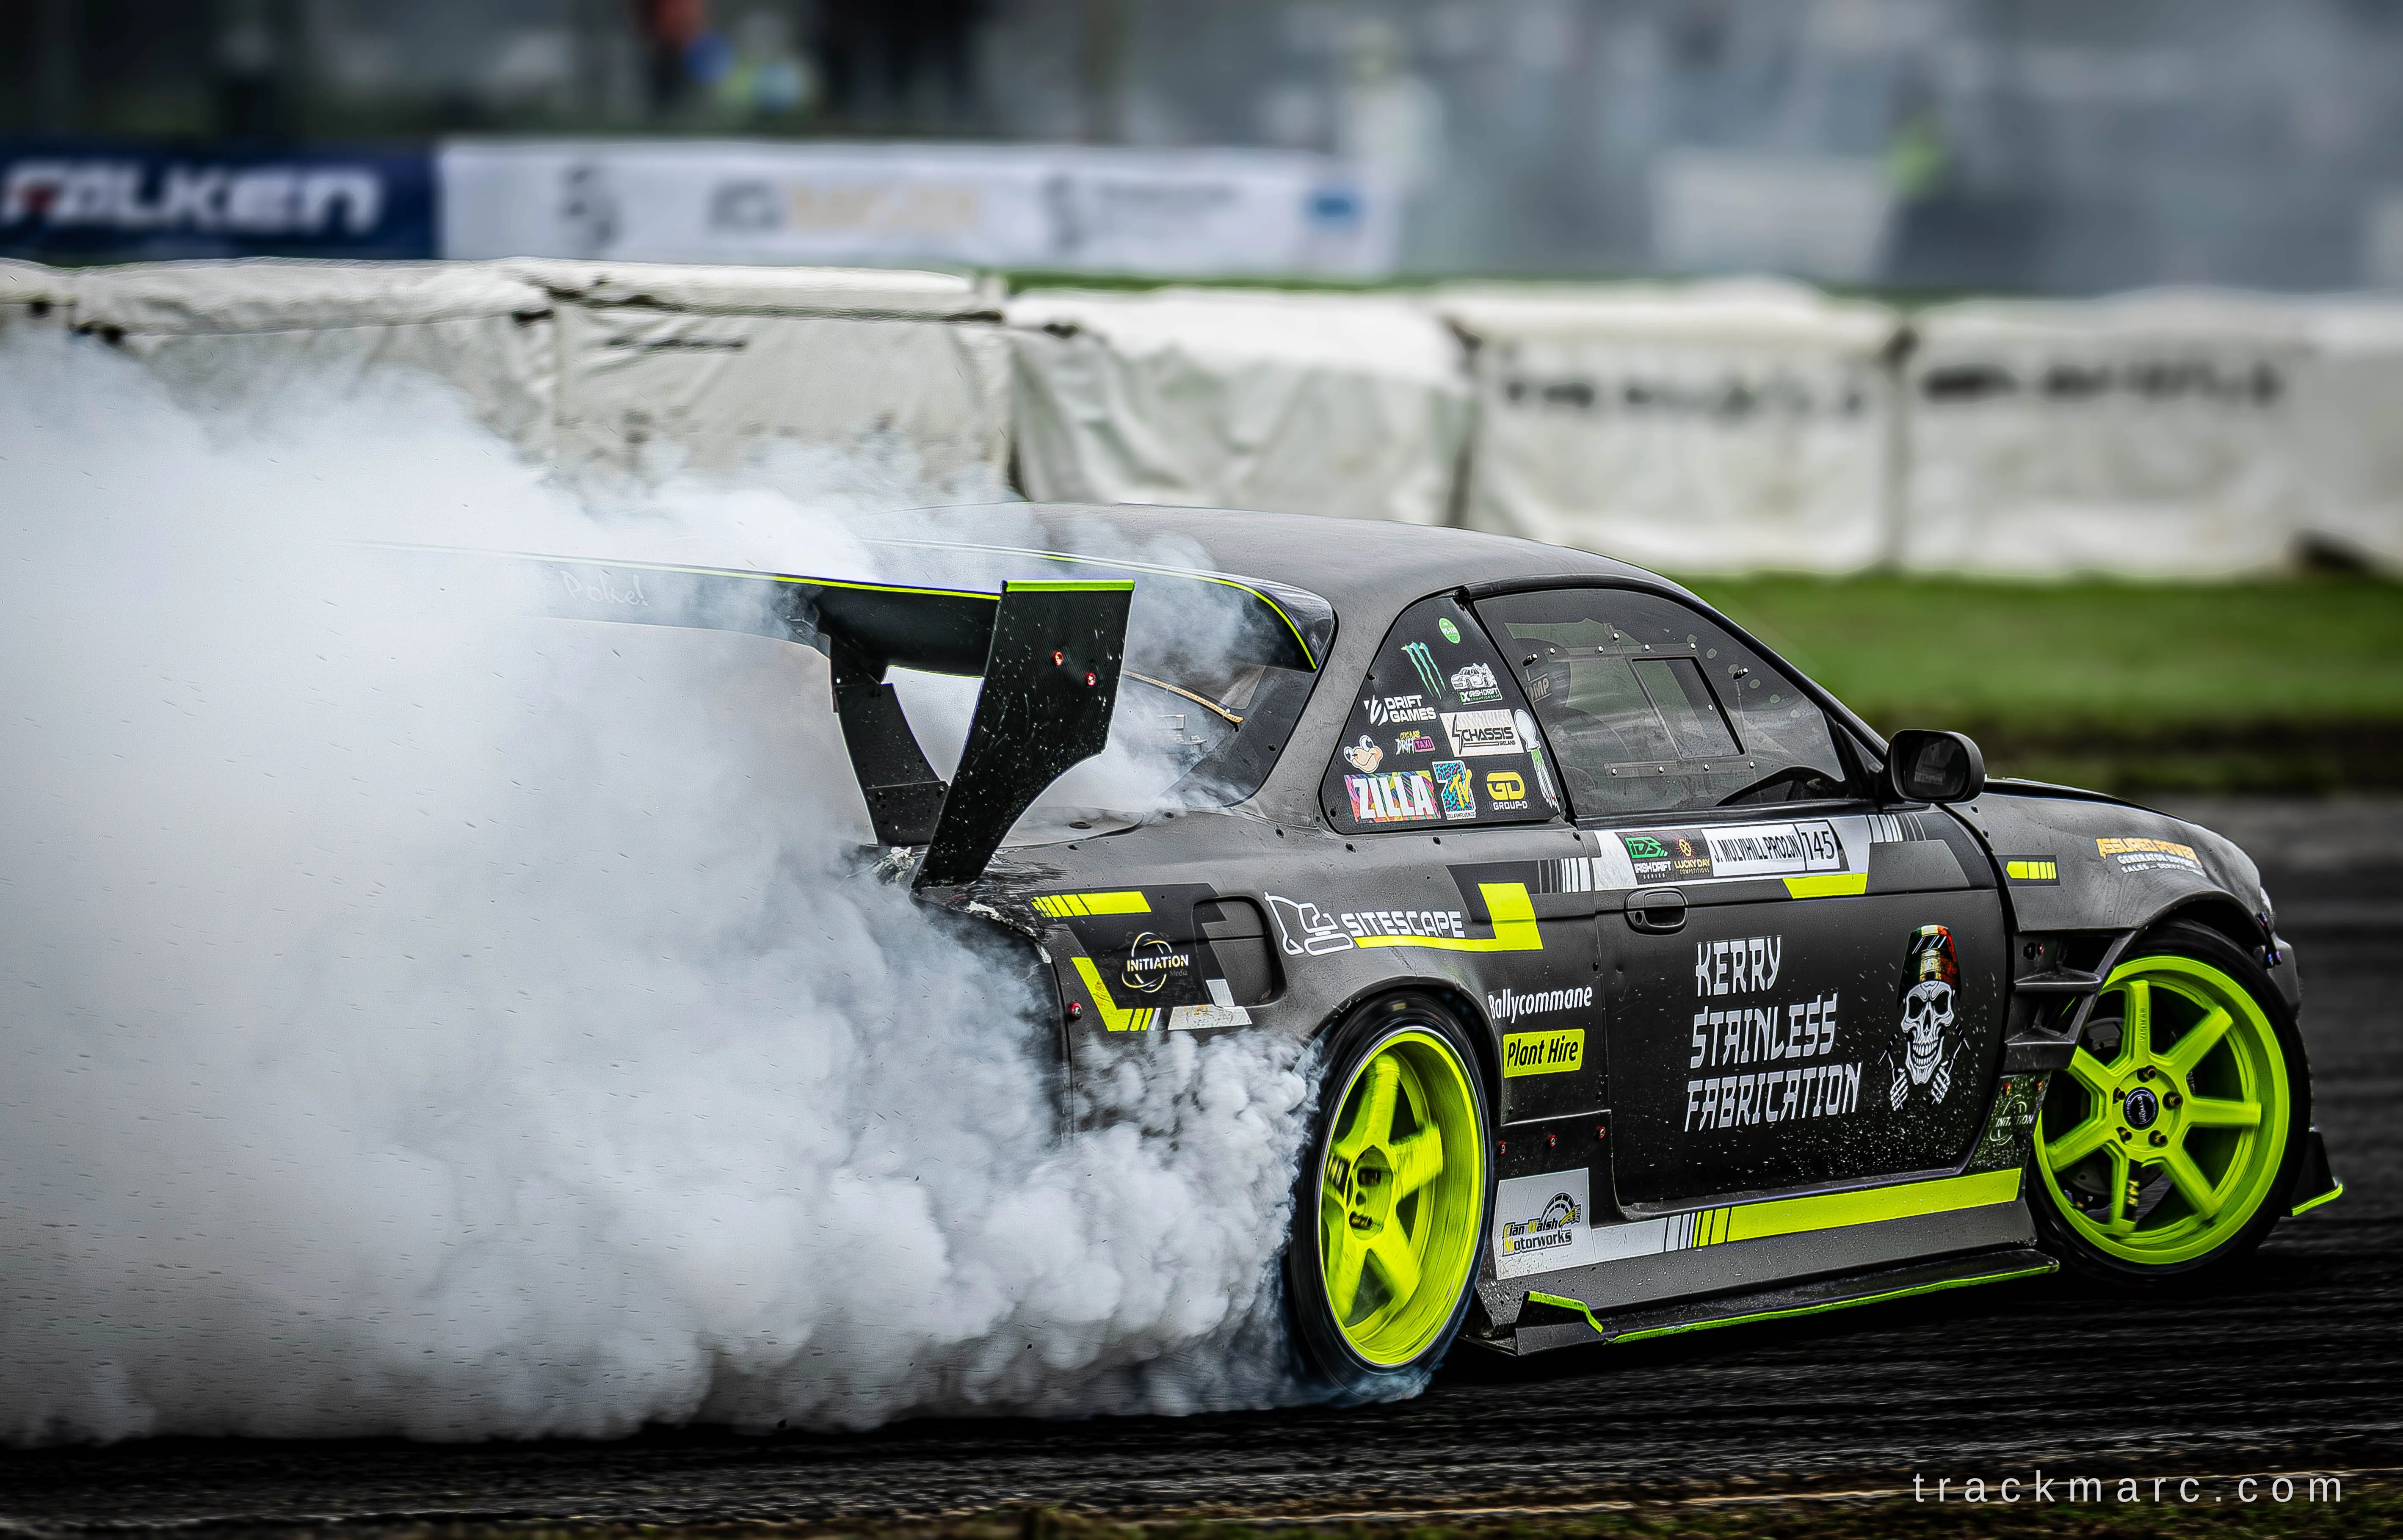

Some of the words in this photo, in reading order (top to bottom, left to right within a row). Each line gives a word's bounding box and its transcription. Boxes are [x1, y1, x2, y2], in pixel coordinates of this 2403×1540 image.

[1384, 695, 1422, 710] DRIFT
[1389, 707, 1436, 723] GAMES
[1415, 740, 1431, 748] TAXI
[1353, 776, 1434, 819] ZILLA
[1710, 840, 1723, 863] J.
[1718, 837, 1768, 862] MULVIHILL
[1801, 831, 1835, 861] 145
[2096, 838, 2159, 860] ASSURED
[2153, 840, 2203, 867] POWER
[2117, 853, 2168, 864] GENERATOR
[1674, 859, 1696, 869] LUCKY
[1696, 858, 1710, 868] DAY
[2121, 864, 2150, 873] SALES
[1341, 911, 1465, 938] SITESCAPE
[1170, 969, 1188, 977] Media
[1696, 935, 1782, 998] KERRY
[1488, 987, 1592, 1024] Ballycommane
[1690, 992, 1838, 1070] STAINLESS
[1507, 1038, 1545, 1068] Plant
[1547, 1035, 1578, 1063] Hire
[1684, 1062, 1863, 1132] FABRICATION
[1504, 1225, 1525, 1237] Cian
[1528, 1217, 1558, 1234] Walsh
[1504, 1230, 1572, 1253] Motorworks
